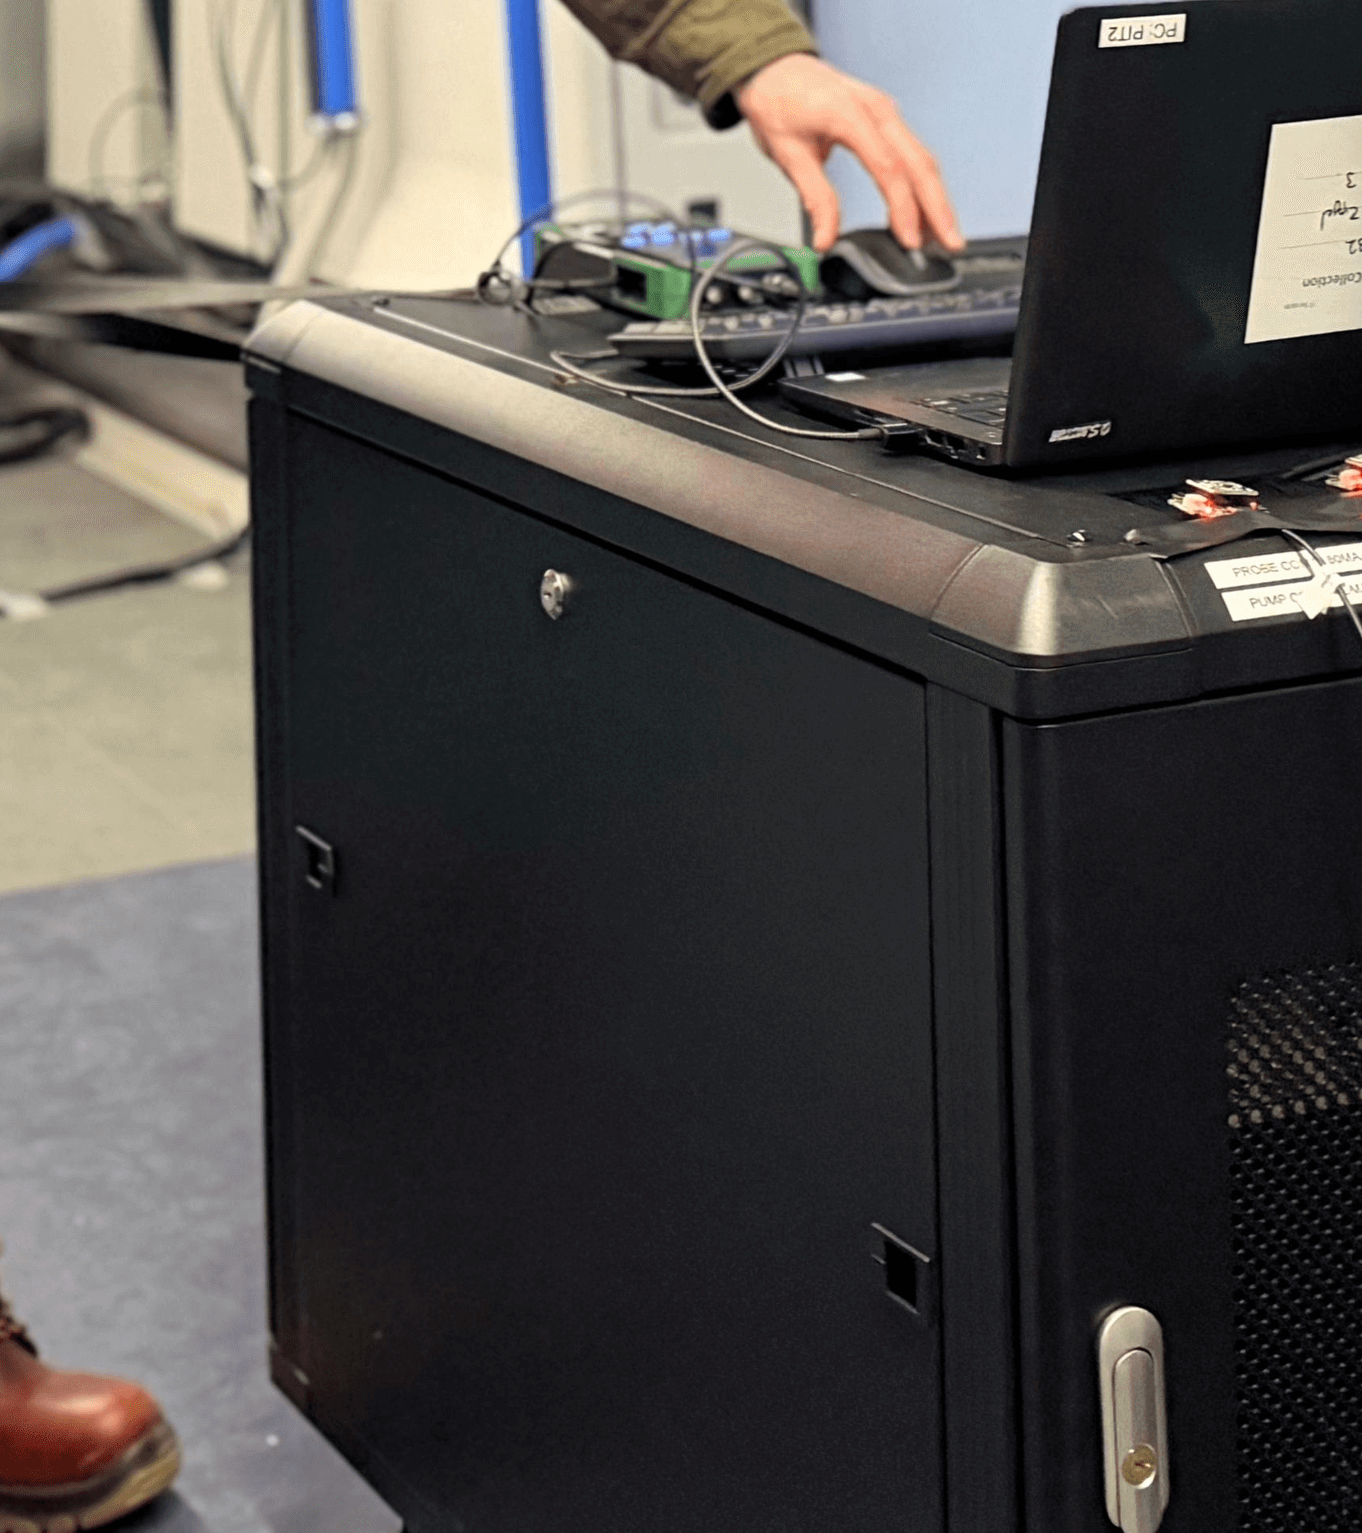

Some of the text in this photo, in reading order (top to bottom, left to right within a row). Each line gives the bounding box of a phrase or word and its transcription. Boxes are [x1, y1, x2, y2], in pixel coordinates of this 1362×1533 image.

[1108, 24, 1144, 42] PIT2
[1346, 172, 1357, 188] 3
[1302, 272, 1362, 288] Collection
